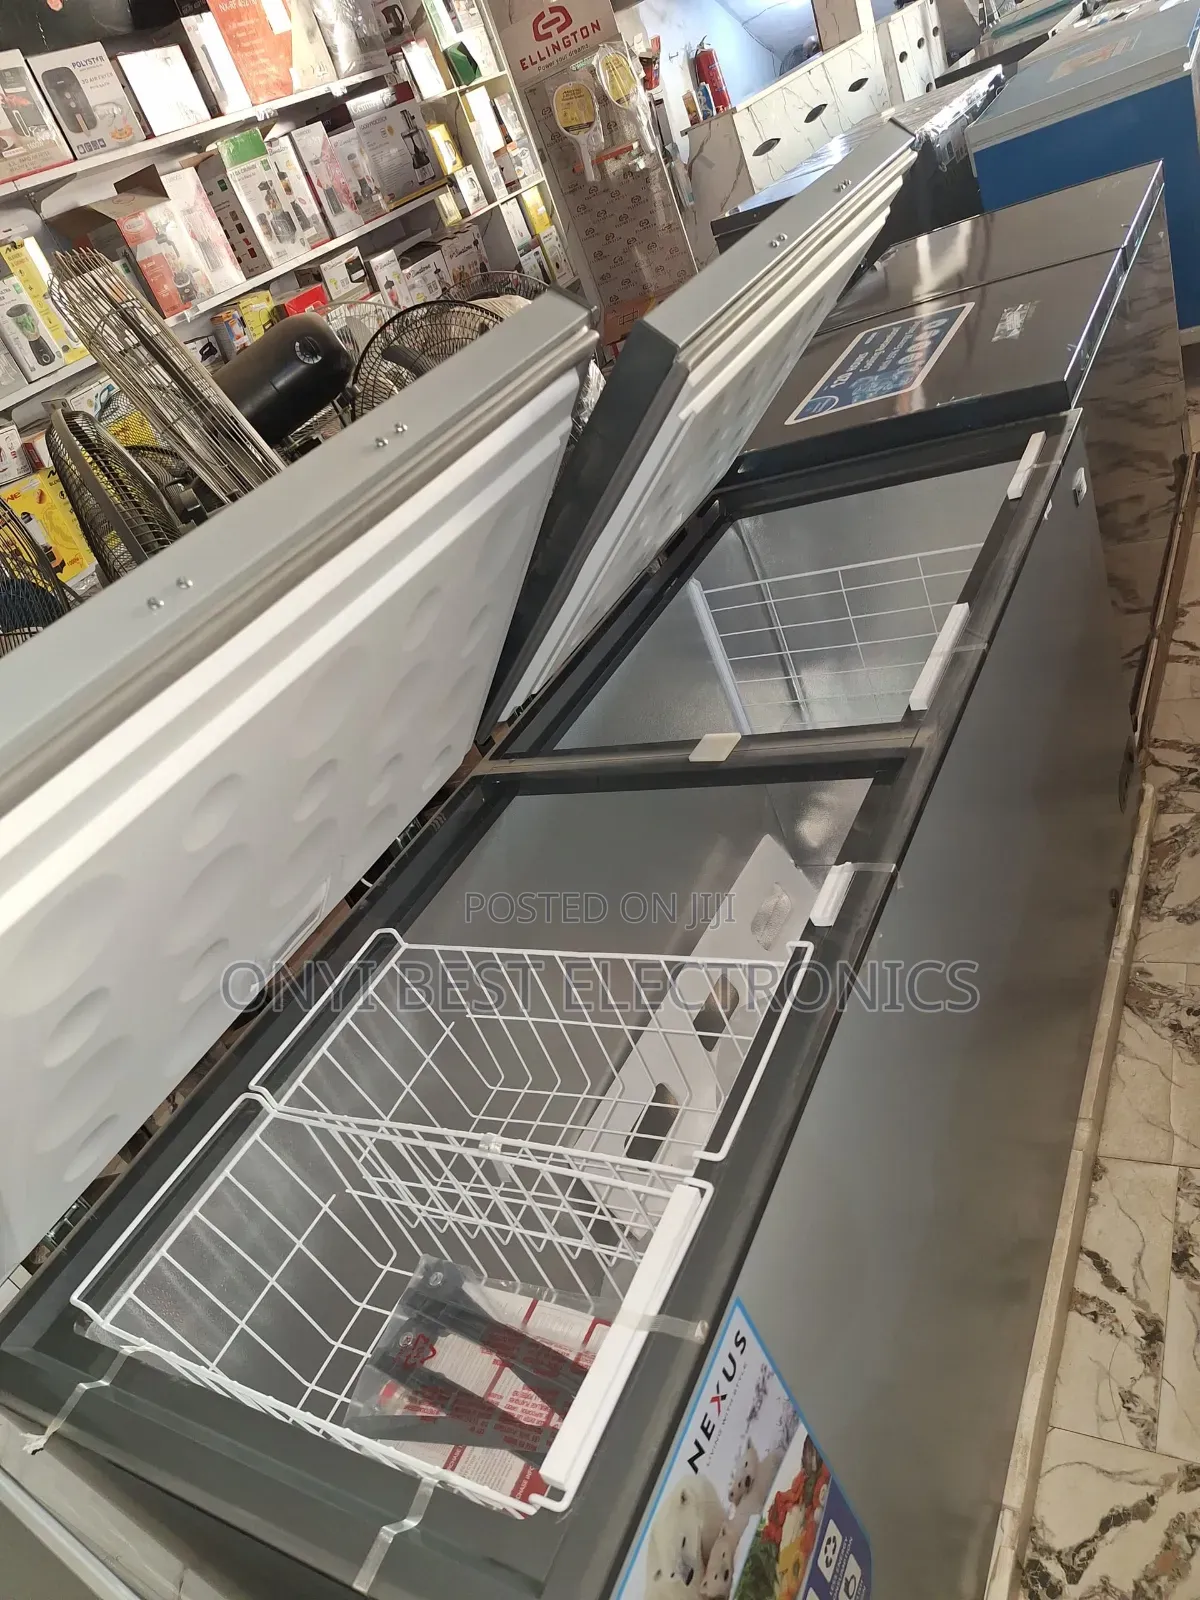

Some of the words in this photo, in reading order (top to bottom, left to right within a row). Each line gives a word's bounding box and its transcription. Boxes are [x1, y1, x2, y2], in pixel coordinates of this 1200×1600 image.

[519, 19, 601, 71] ELLINGTON
[537, 60, 555, 73] Power
[556, 55, 568, 66] your
[687, 1329, 747, 1475] NEXUS
